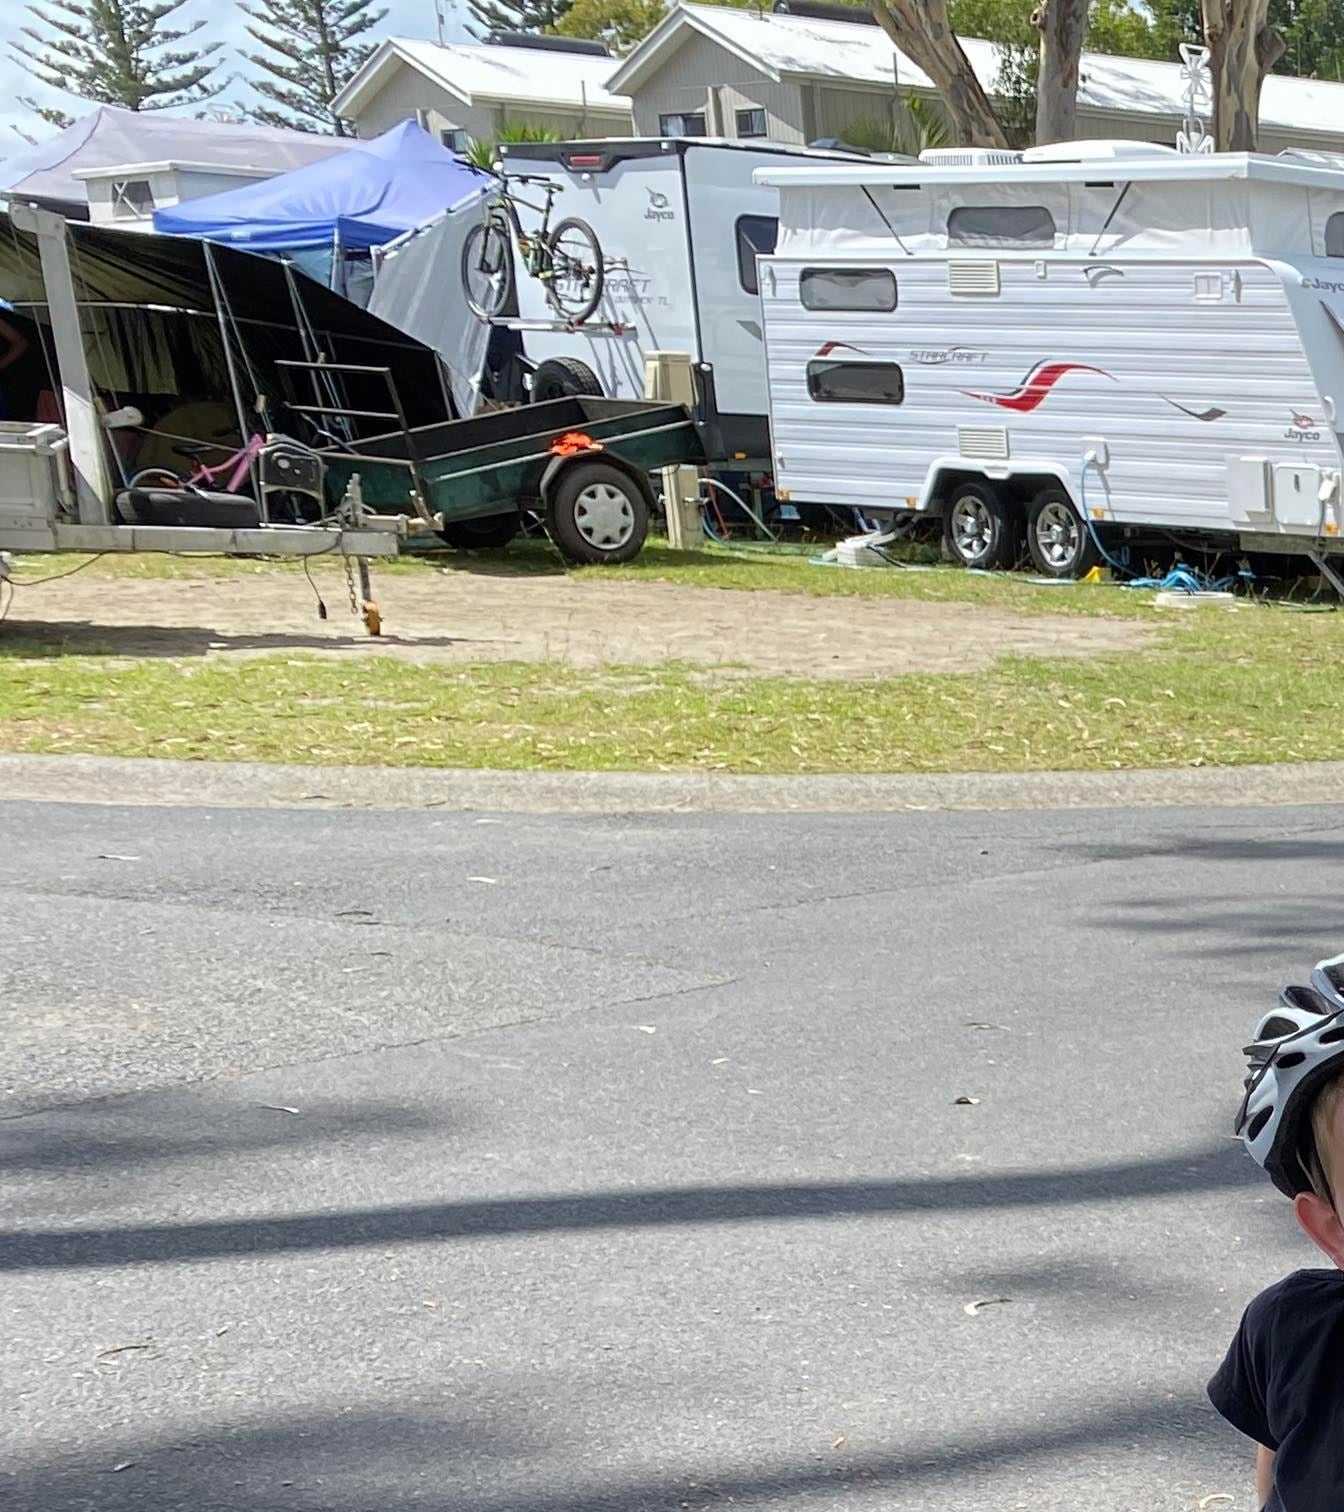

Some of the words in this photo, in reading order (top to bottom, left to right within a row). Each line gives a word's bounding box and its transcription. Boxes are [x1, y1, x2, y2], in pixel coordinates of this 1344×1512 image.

[643, 207, 675, 222] Jayco
[908, 349, 990, 363] STARCRAFT
[1284, 428, 1321, 443] Jayco
